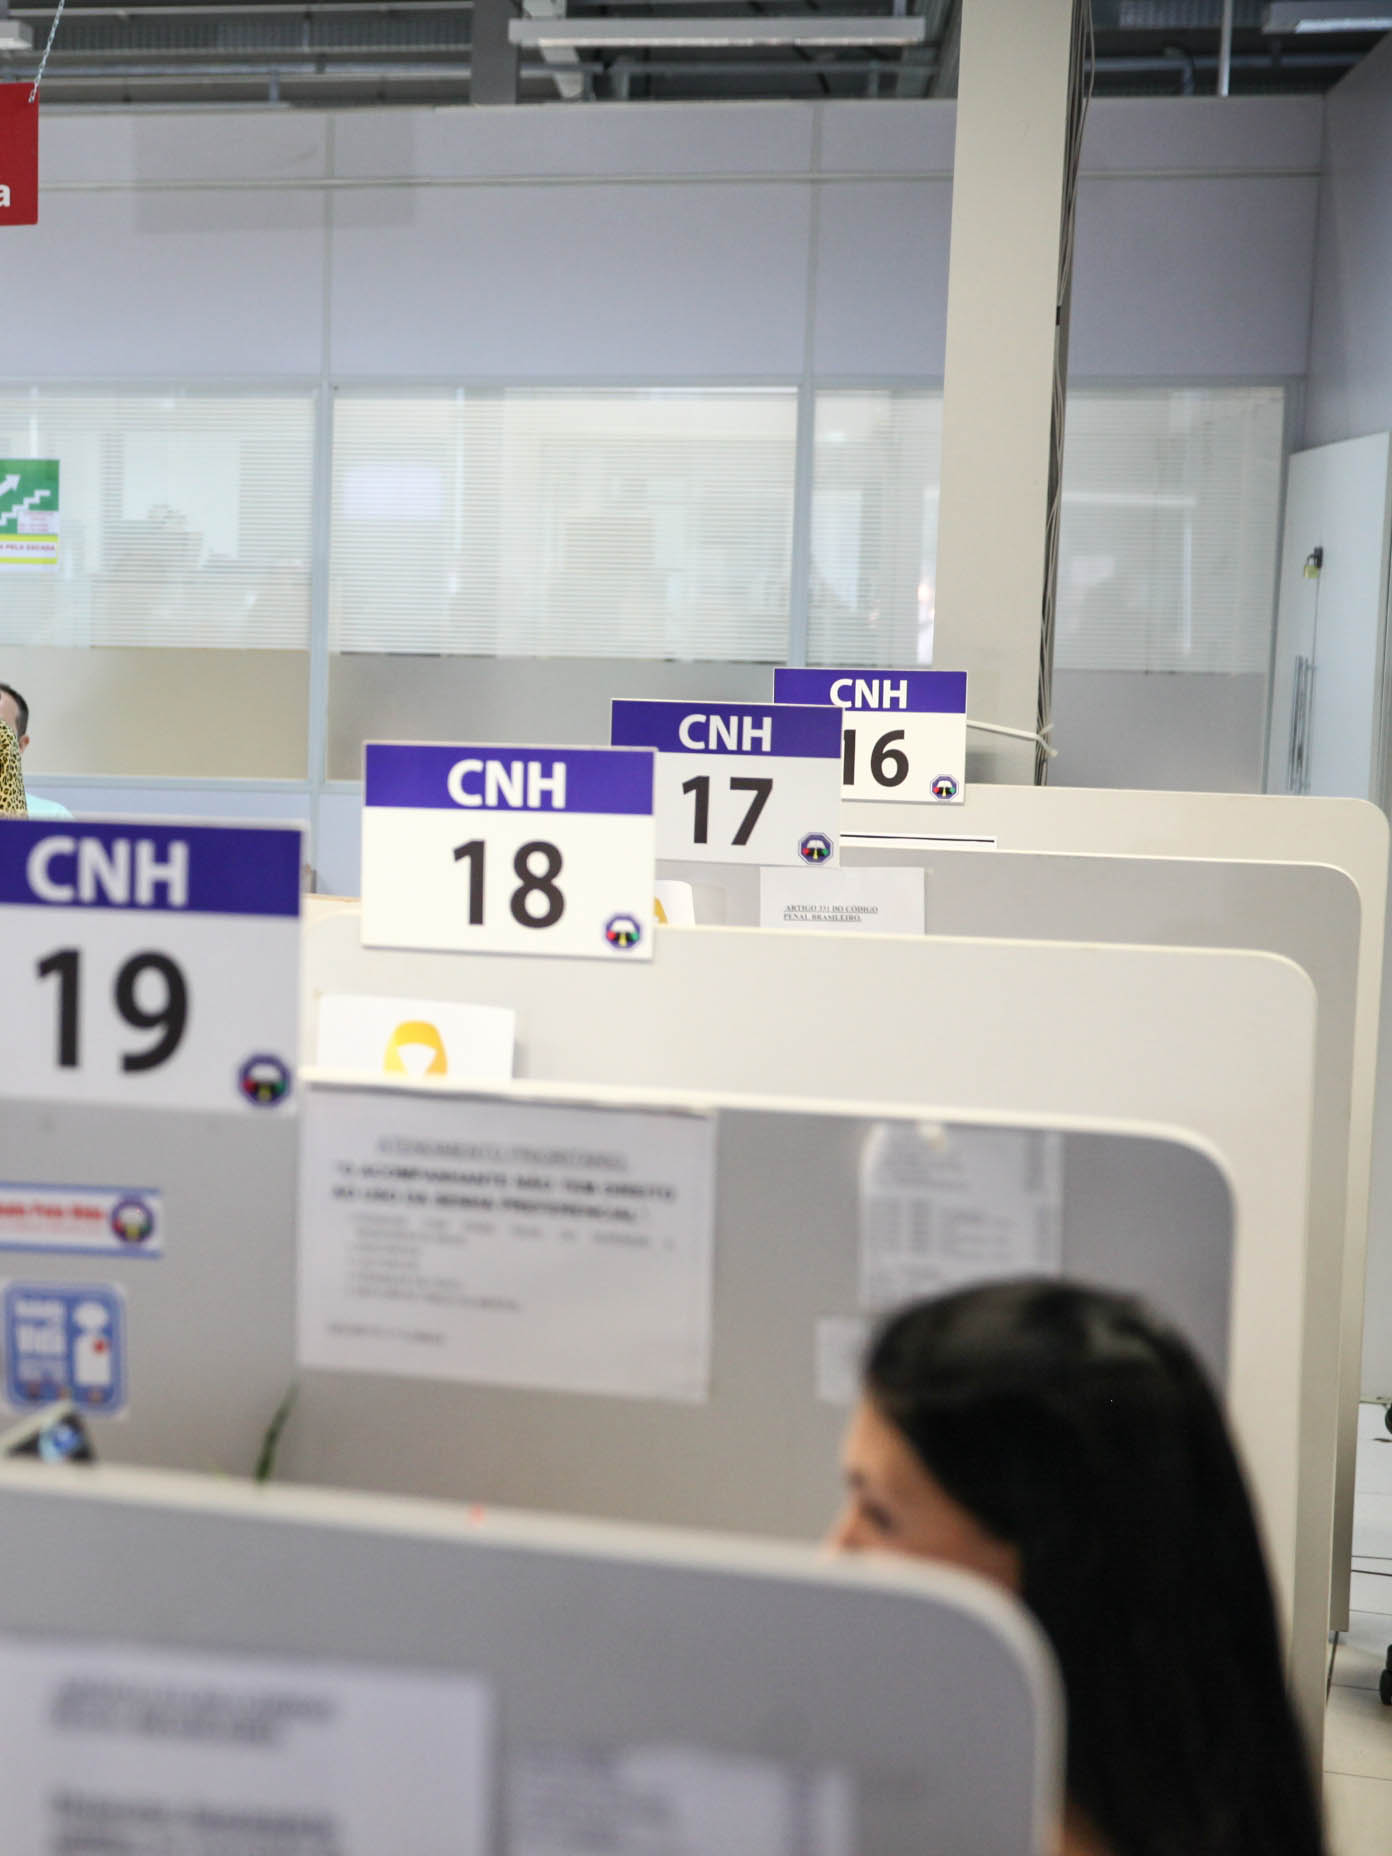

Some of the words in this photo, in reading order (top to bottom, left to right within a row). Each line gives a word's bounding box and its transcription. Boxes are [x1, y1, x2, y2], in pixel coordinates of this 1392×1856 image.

[829, 678, 908, 709] CNH
[679, 714, 773, 752] CNH
[843, 729, 909, 787] 16
[447, 758, 567, 809] CNH
[682, 775, 773, 846] 17
[26, 834, 190, 908] CNH
[453, 840, 565, 929] 18
[36, 946, 189, 1074] 19
